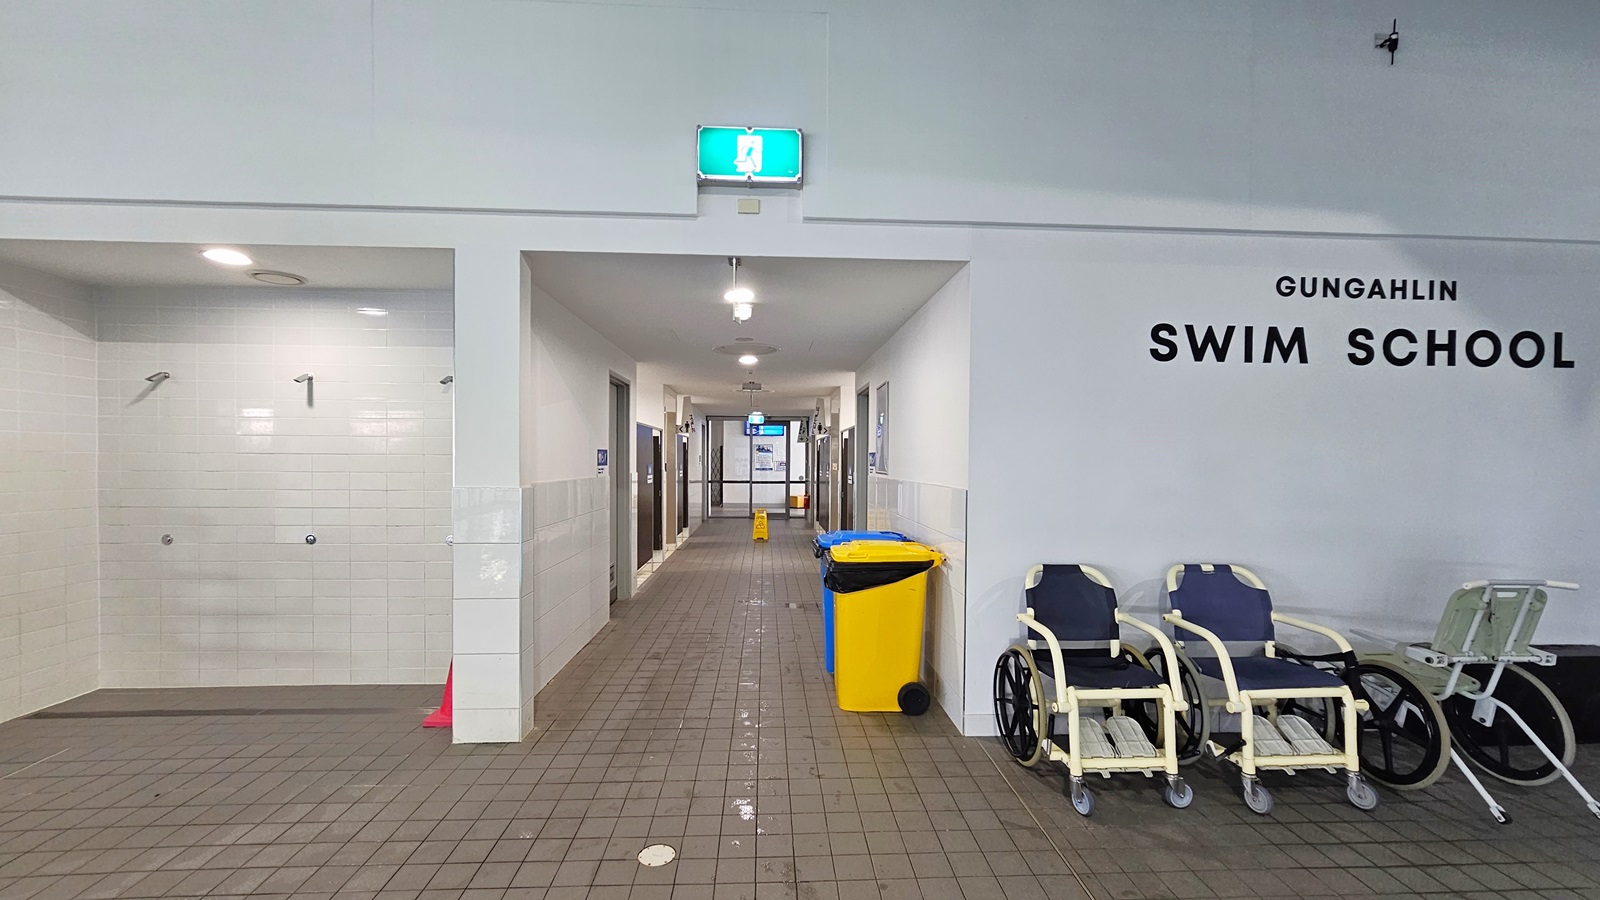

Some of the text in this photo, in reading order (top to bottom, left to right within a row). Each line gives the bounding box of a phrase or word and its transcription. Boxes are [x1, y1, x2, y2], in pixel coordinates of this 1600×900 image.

[1275, 275, 1457, 302] GUNGAHLIN
[1149, 322, 1575, 369] SWIM SCHOOL
